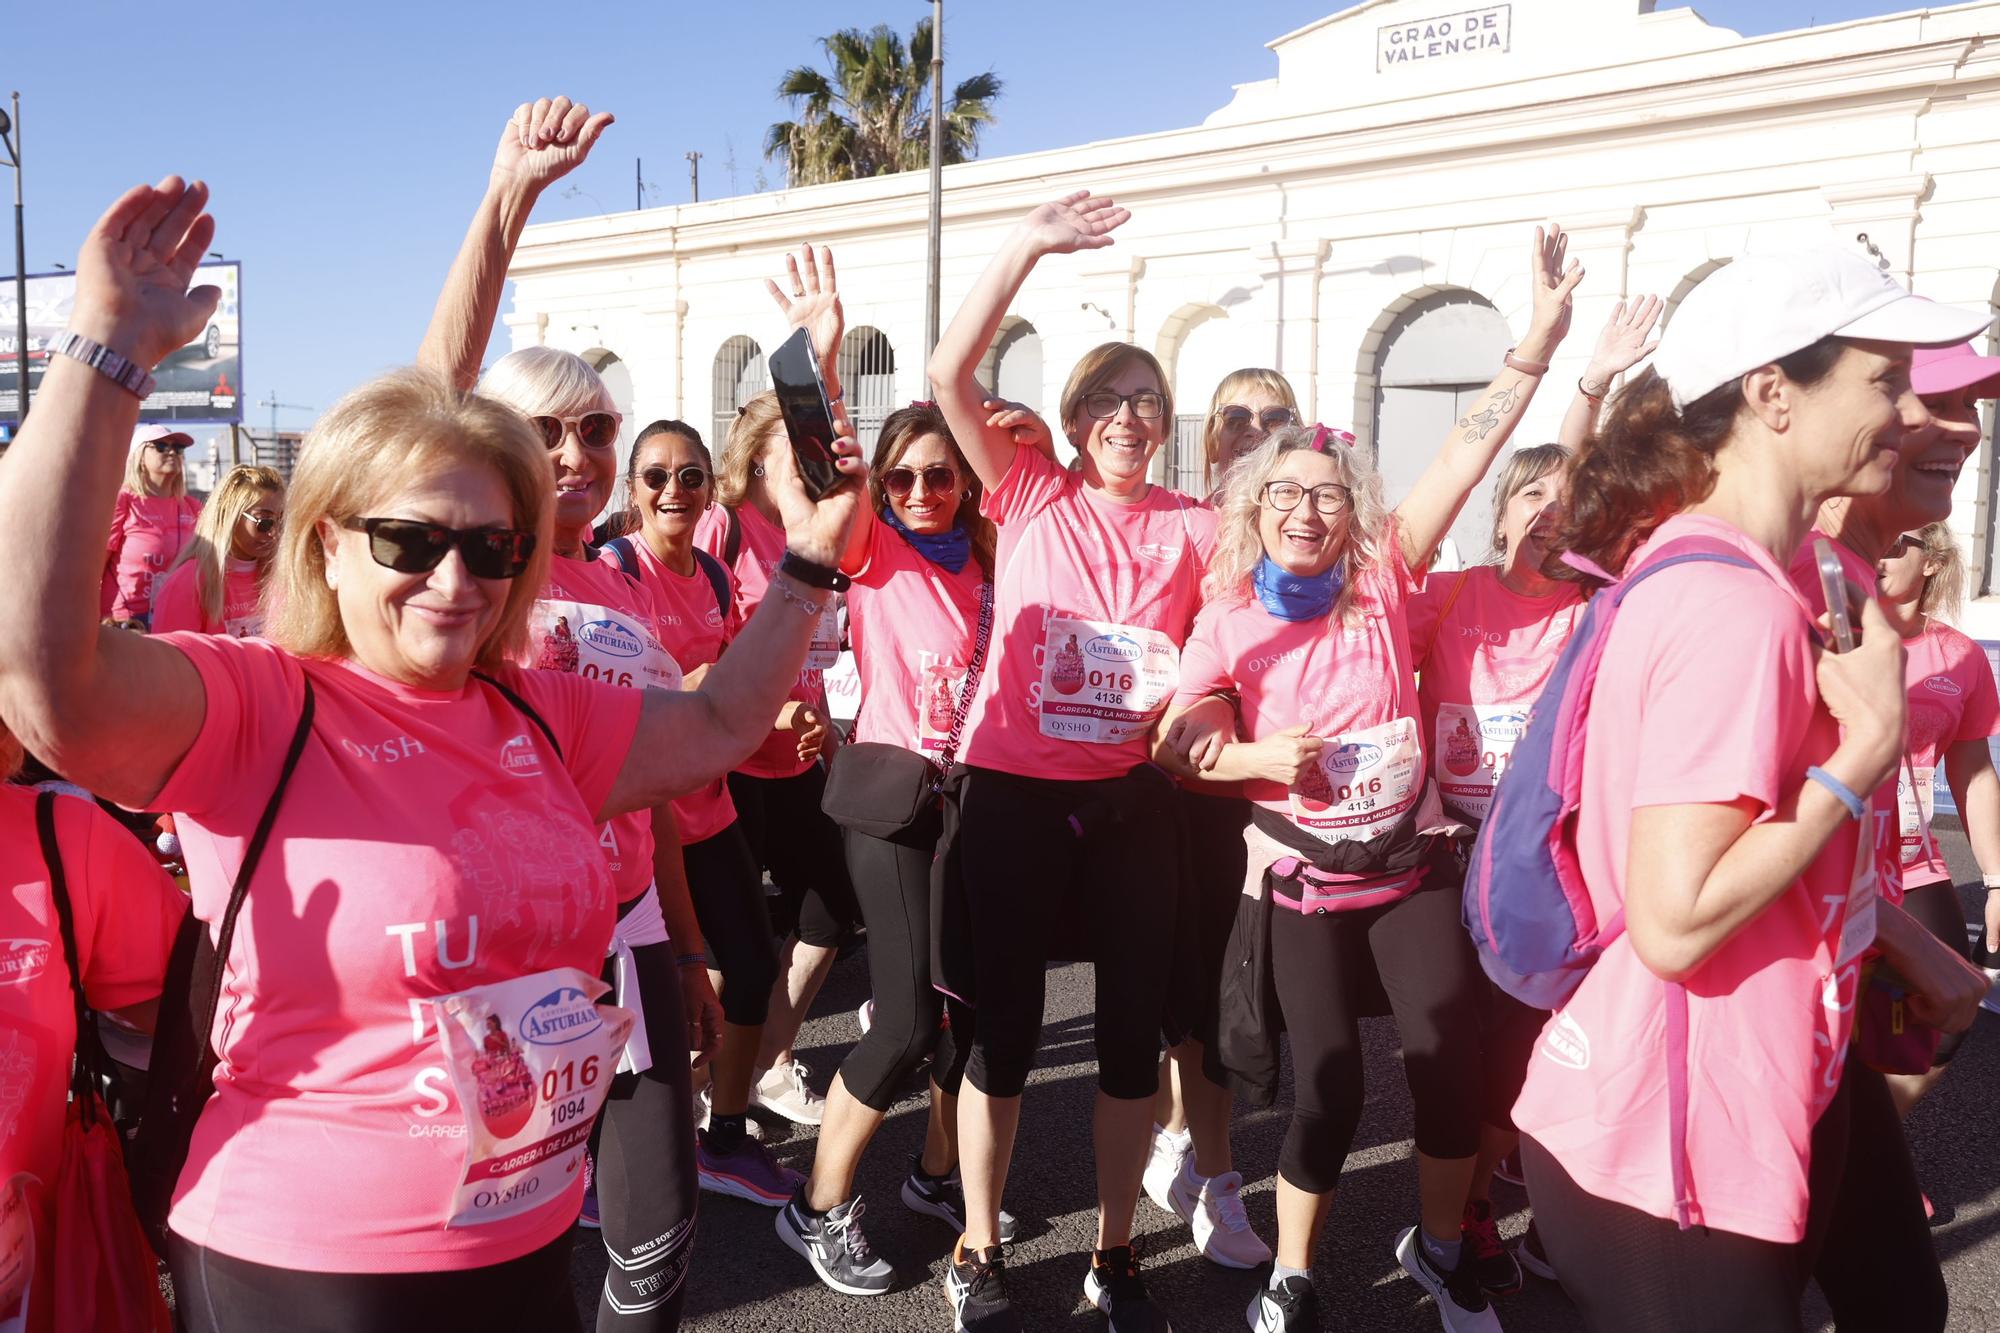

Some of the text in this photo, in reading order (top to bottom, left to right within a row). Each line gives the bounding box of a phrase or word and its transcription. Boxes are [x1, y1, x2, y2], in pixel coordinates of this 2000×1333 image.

[1390, 13, 1497, 45] GRAO DE
[1385, 32, 1500, 64] VALENCIA
[584, 628, 639, 653] ASTURIANA
[1090, 642, 1170, 657] ASTURIANA SUMA
[1248, 647, 1305, 672] OYSHO
[582, 663, 633, 689] 016
[1088, 670, 1133, 691] 016
[1095, 692, 1123, 704] 4136
[1055, 705, 1092, 714] CARRERA
[1093, 708, 1103, 716] DE
[1104, 710, 1114, 718] LA
[1115, 712, 1142, 721] MUJER
[1052, 720, 1091, 732] OYSHO
[1385, 735, 1410, 748] SUMA
[1331, 752, 1379, 769] ASTURIANA
[1338, 777, 1381, 801] 016
[1453, 786, 1489, 795] CARRERA
[1310, 819, 1347, 827] CARRERA
[1372, 807, 1396, 820] MUJER
[1347, 798, 1376, 811] 4134
[385, 914, 479, 978] TU
[543, 1054, 600, 1101] 016
[550, 1096, 585, 1126] 1094
[490, 1147, 543, 1173] CARRERA
[545, 1138, 561, 1157] DE
[561, 1134, 574, 1147] LA
[473, 1176, 540, 1208] OYSHO
[631, 1241, 656, 1256] SINCE
[655, 1218, 689, 1245] FOREVER
[630, 1264, 677, 1296] THE
